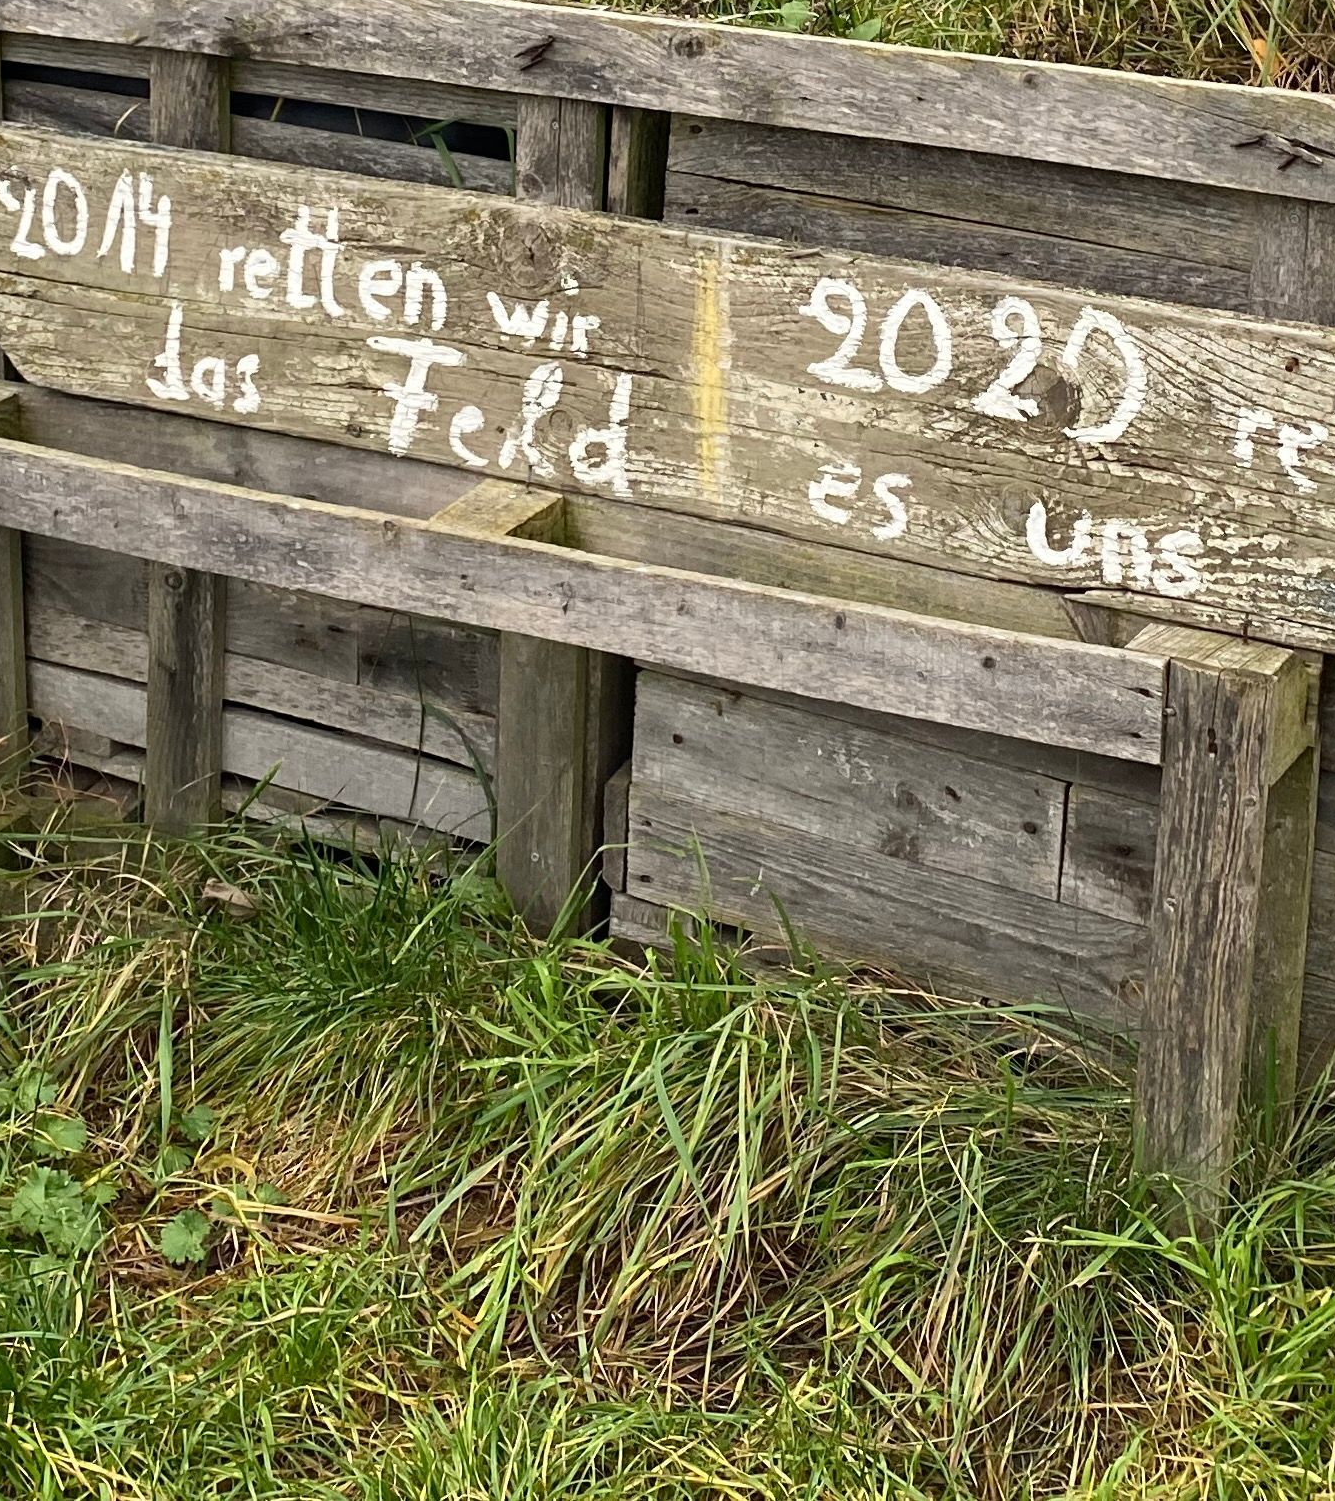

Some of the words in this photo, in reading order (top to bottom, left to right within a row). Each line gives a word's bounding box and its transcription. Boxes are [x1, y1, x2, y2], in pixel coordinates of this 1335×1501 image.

[219, 204, 446, 332] retten
[485, 274, 602, 358] wir
[799, 277, 1148, 444] 2020
[146, 301, 262, 415] das
[366, 336, 633, 498] Feld
[808, 460, 912, 541] es
[1026, 497, 1205, 596] uns
